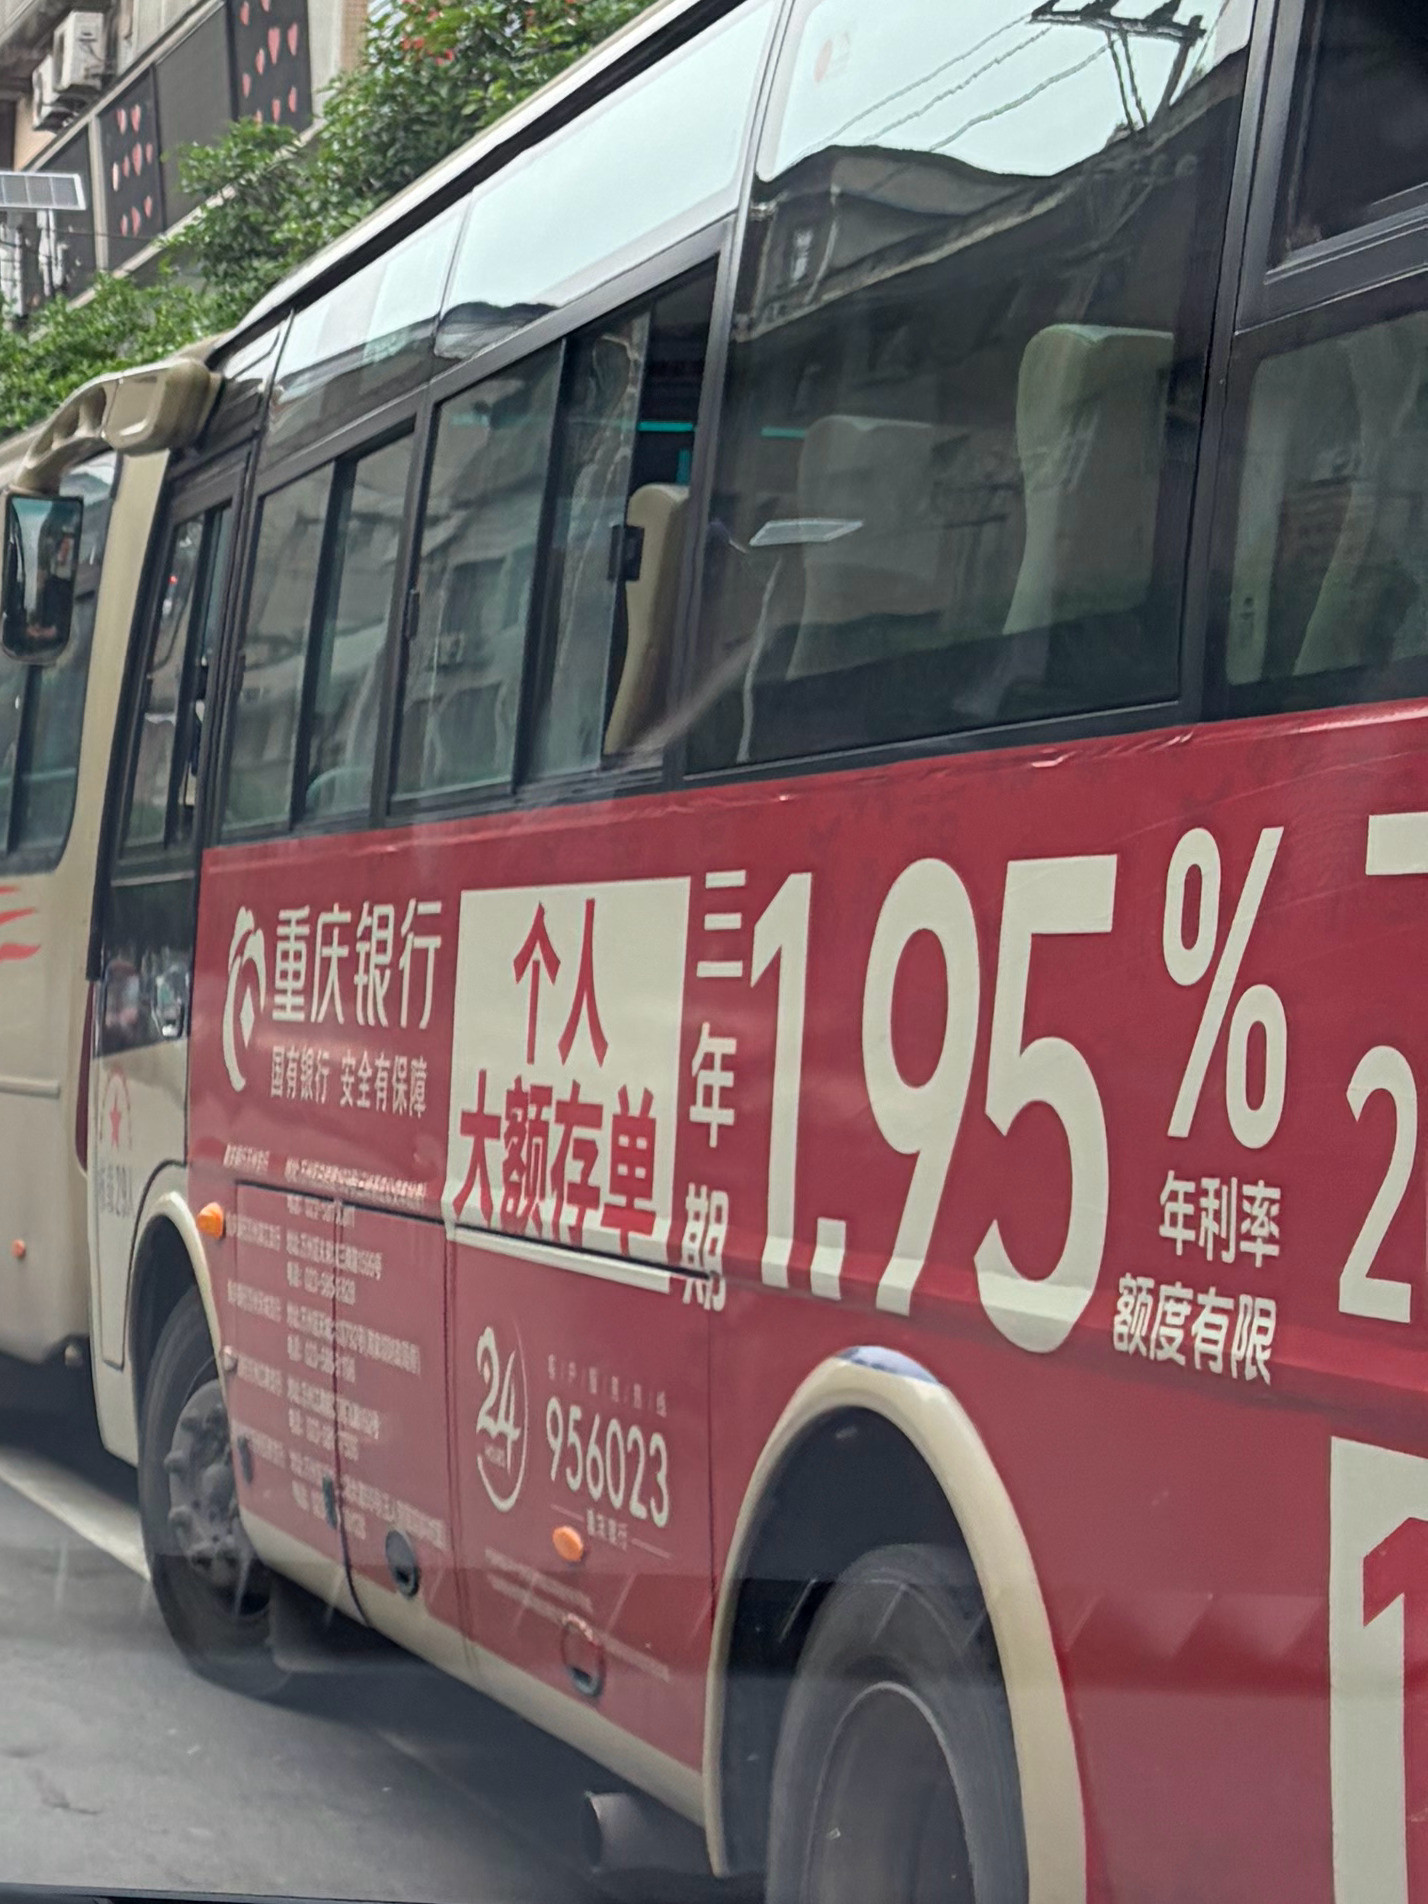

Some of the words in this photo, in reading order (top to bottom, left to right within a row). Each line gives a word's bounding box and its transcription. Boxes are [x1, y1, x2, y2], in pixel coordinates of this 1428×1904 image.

[271, 898, 442, 1030] 重庆银行
[512, 898, 609, 1068] 个人
[270, 1045, 331, 1104] 国有银行
[339, 1049, 428, 1119] 安全有保障
[681, 869, 746, 1312] 三年期
[452, 1068, 658, 1257] 大额存单
[1158, 1169, 1282, 1268] 年利率
[1111, 1272, 1278, 1385] 额度有限
[546, 1396, 670, 1528] 956023
